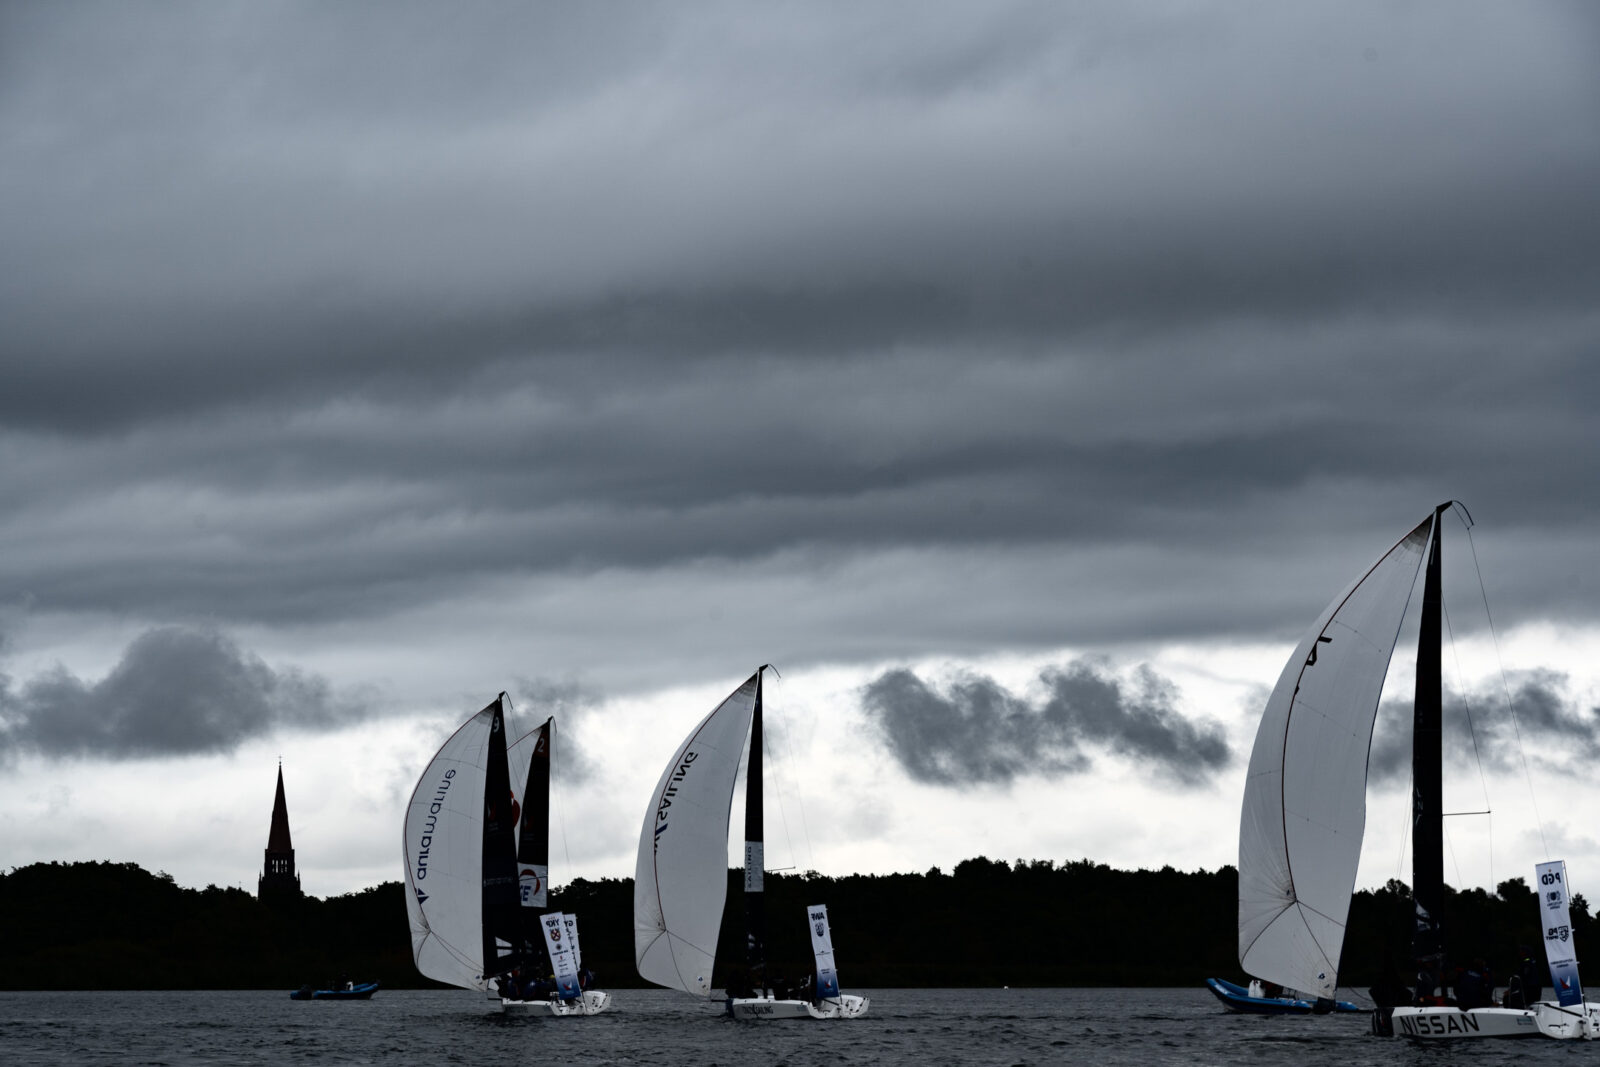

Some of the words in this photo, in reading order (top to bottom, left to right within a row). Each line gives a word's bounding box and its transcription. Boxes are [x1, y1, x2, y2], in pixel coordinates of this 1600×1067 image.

[493, 717, 500, 733] 9
[537, 738, 545, 753] 2
[1399, 1013, 1480, 1035] NISSAN
